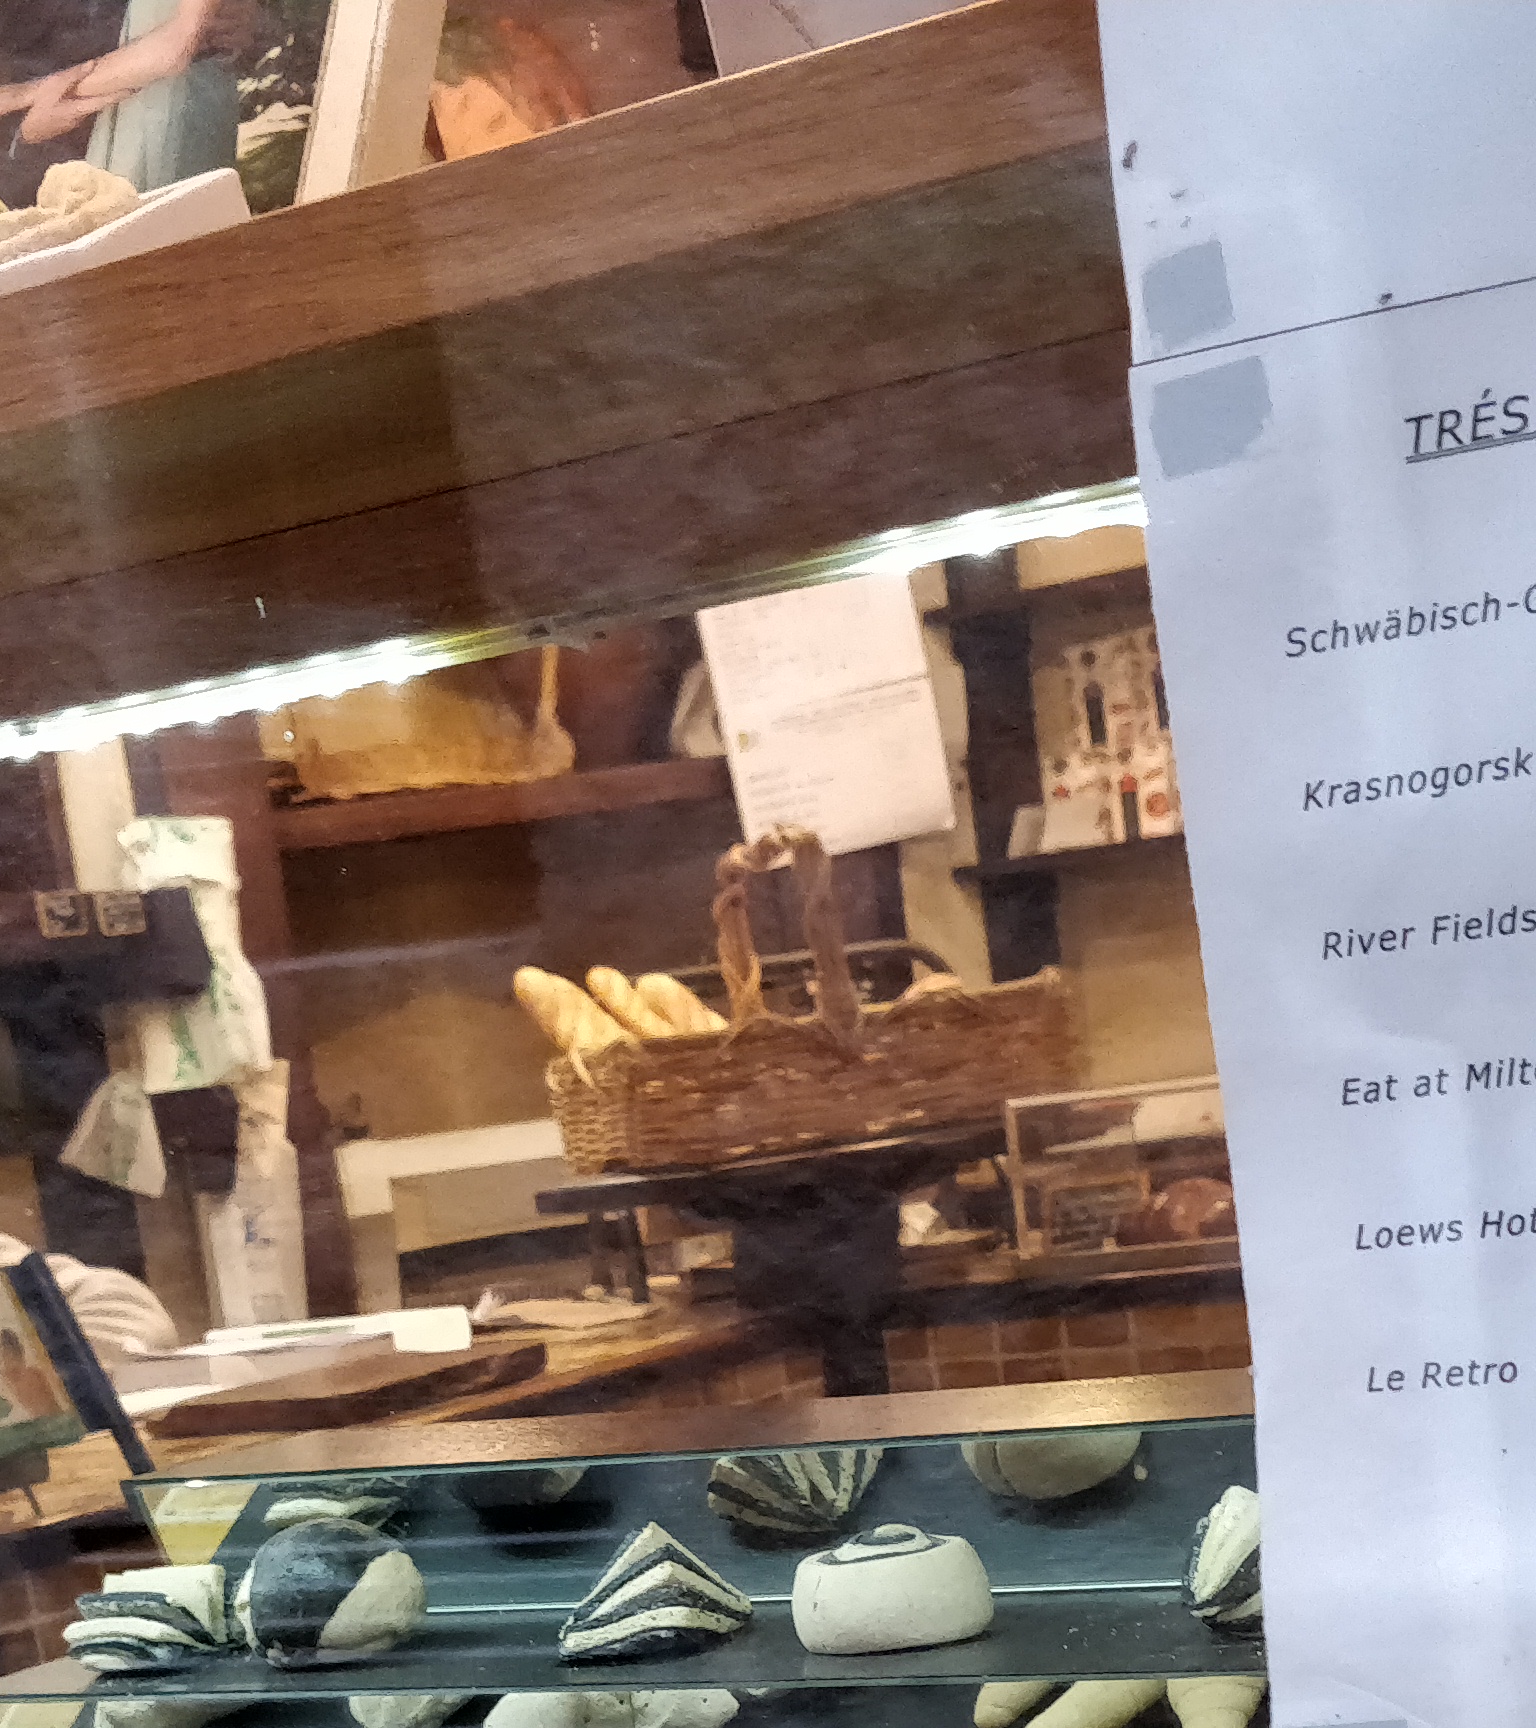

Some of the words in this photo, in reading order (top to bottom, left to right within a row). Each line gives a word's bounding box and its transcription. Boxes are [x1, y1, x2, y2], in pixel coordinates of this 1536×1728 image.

[1403, 388, 1530, 457] TRÉS
[1302, 747, 1533, 811] Krasnogorsk
[1322, 922, 1416, 960] River
[1341, 1075, 1398, 1107] Eat
[1413, 1066, 1449, 1098] at
[1356, 1217, 1463, 1252] Loews
[1367, 1366, 1405, 1393] Le
[1421, 1356, 1518, 1390] Retro
